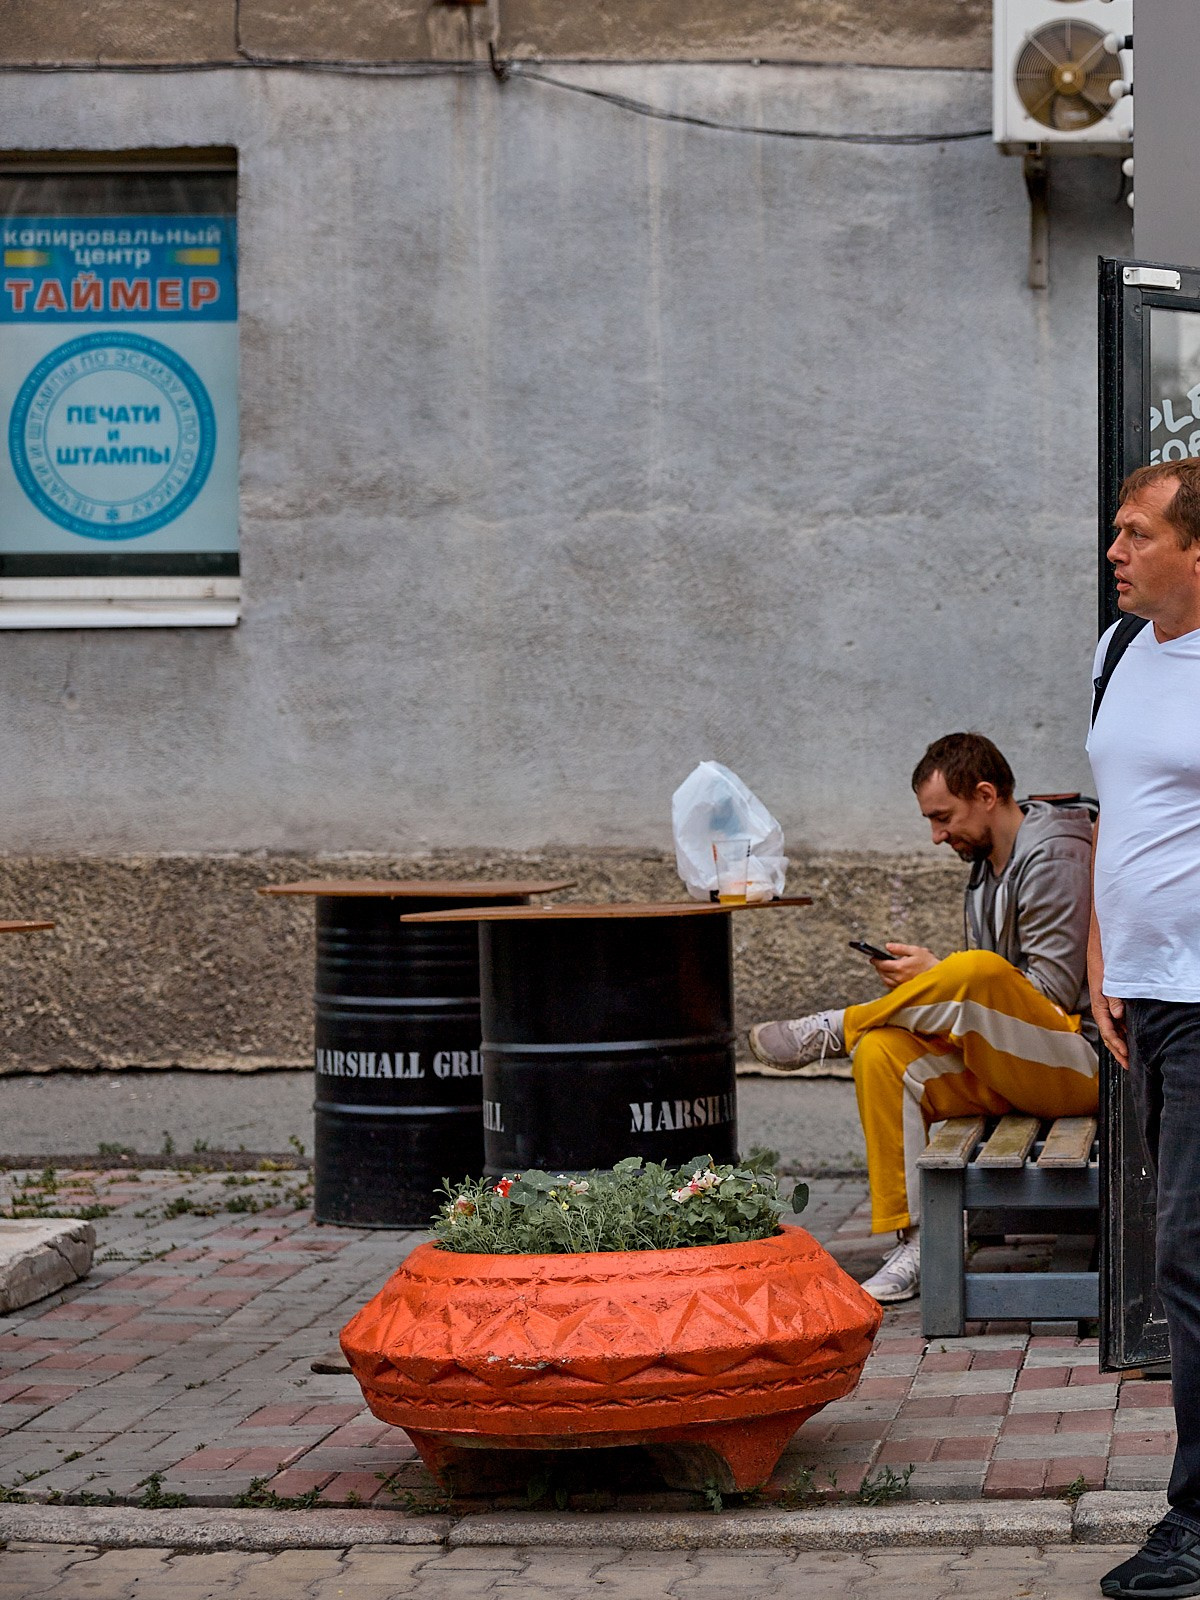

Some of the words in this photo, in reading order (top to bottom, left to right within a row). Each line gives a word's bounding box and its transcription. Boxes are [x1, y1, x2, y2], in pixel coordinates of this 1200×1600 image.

[74, 248, 151, 269] центр
[4, 271, 220, 313] ТАЙМЕР
[66, 405, 160, 425] ПЕЧАТИ
[56, 446, 171, 465] ШТАМПЫ
[433, 1050, 483, 1079] GRI
